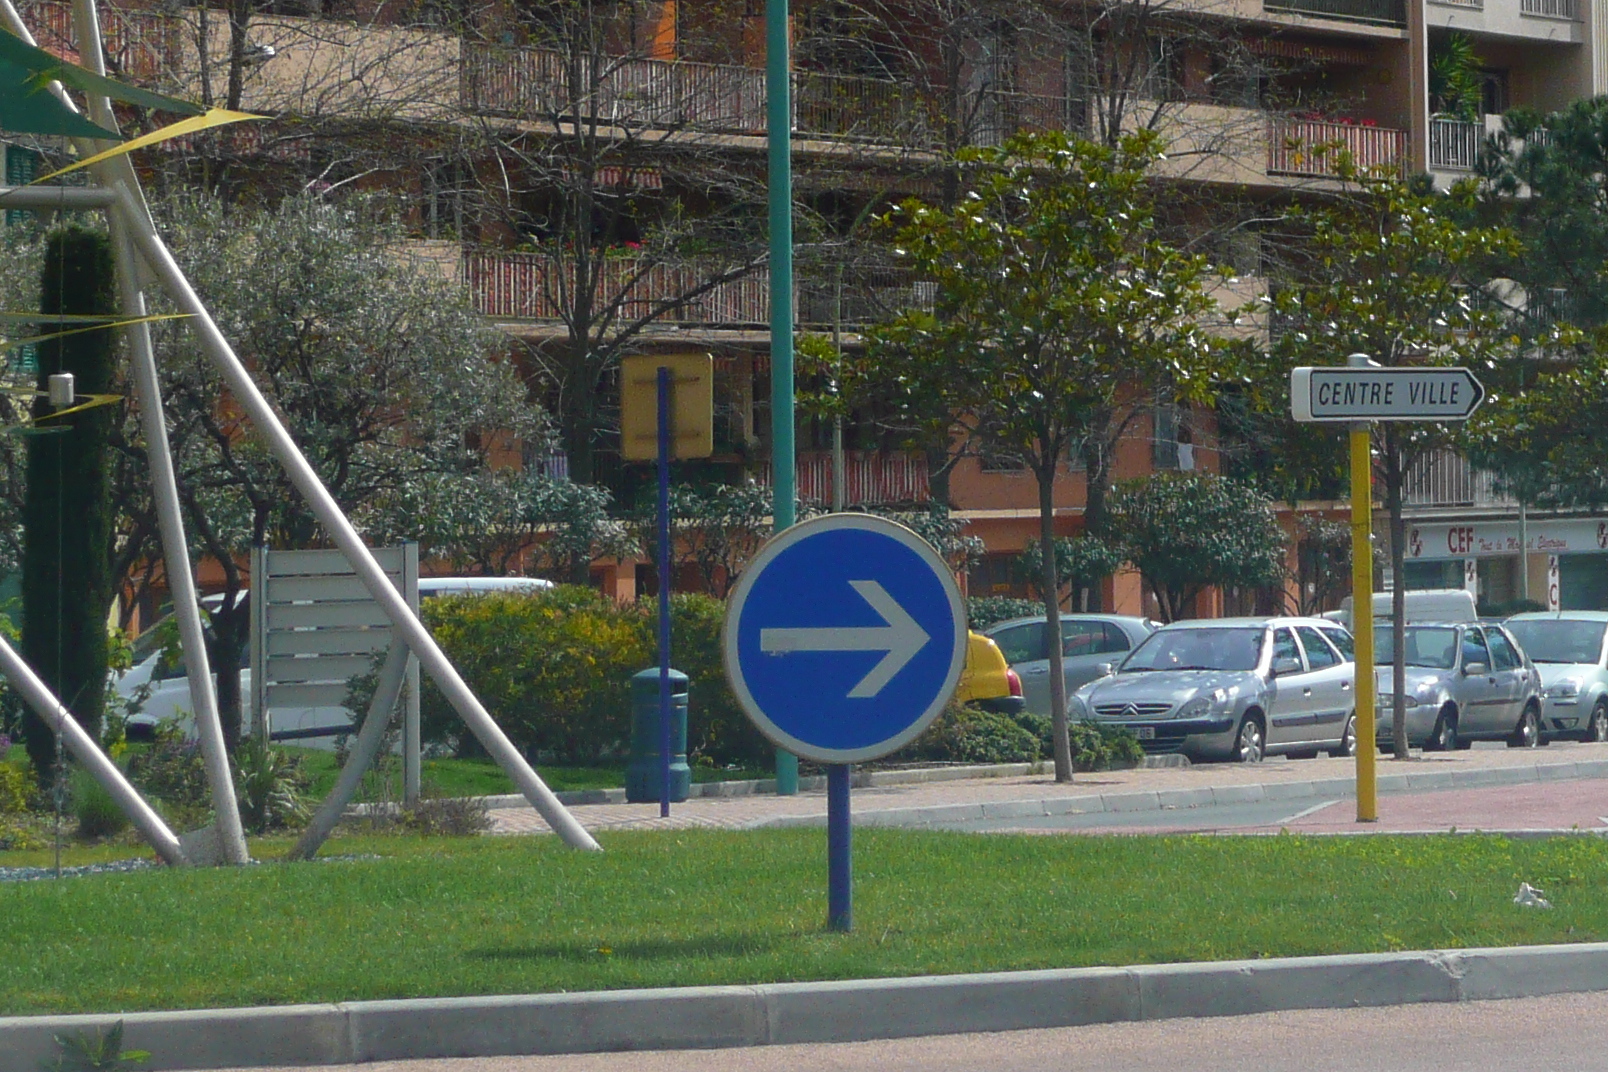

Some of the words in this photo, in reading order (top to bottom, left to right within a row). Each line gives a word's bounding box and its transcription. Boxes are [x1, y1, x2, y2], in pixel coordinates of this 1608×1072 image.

[1318, 381, 1394, 406] CENTRE
[1408, 381, 1460, 405] VILLE
[1448, 527, 1473, 553] CEF
